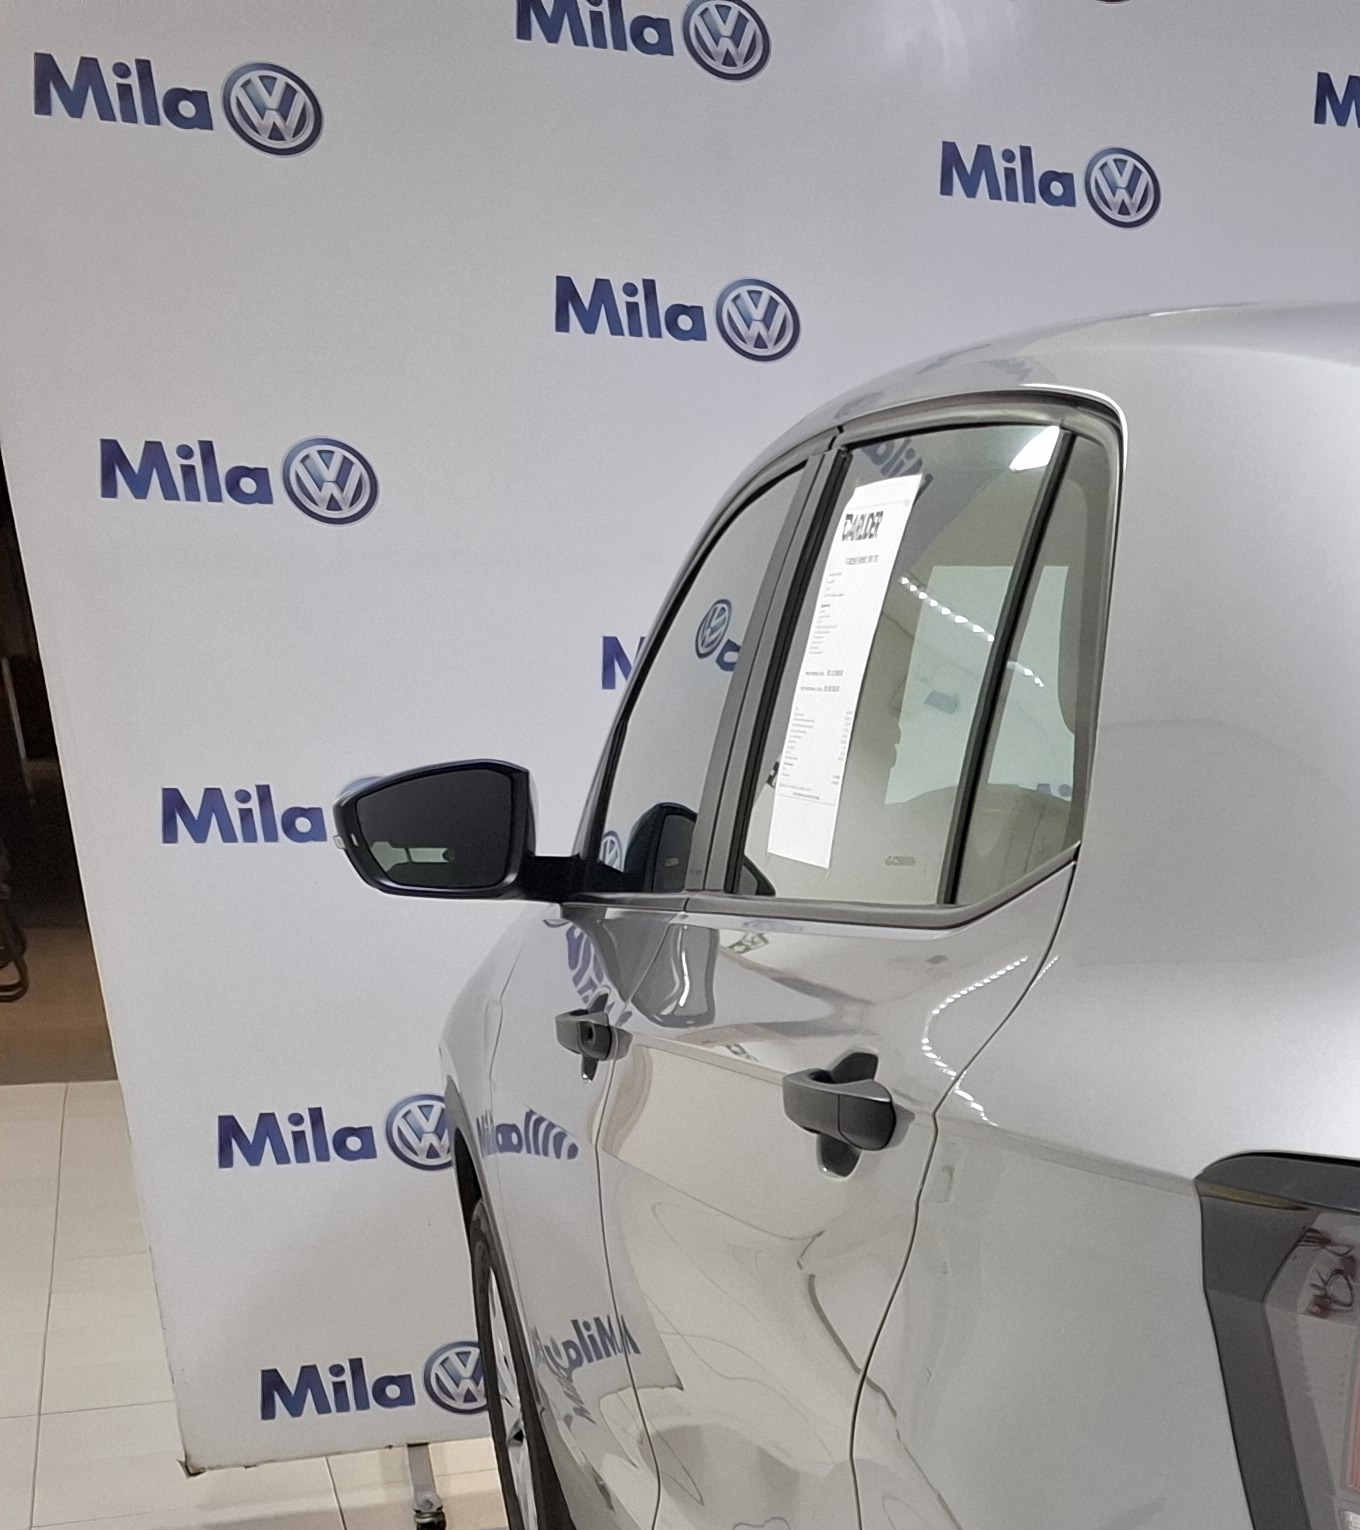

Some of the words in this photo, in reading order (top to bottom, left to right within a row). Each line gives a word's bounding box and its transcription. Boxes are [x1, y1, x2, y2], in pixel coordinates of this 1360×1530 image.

[516, 0, 674, 56] Mila
[33, 52, 213, 131] Mila
[940, 141, 1077, 208] Mila
[554, 275, 708, 343] Mila
[99, 438, 274, 506] Mila
[161, 784, 327, 845] Mila
[217, 1106, 378, 1170] Mila
[259, 1357, 416, 1421] Mila
